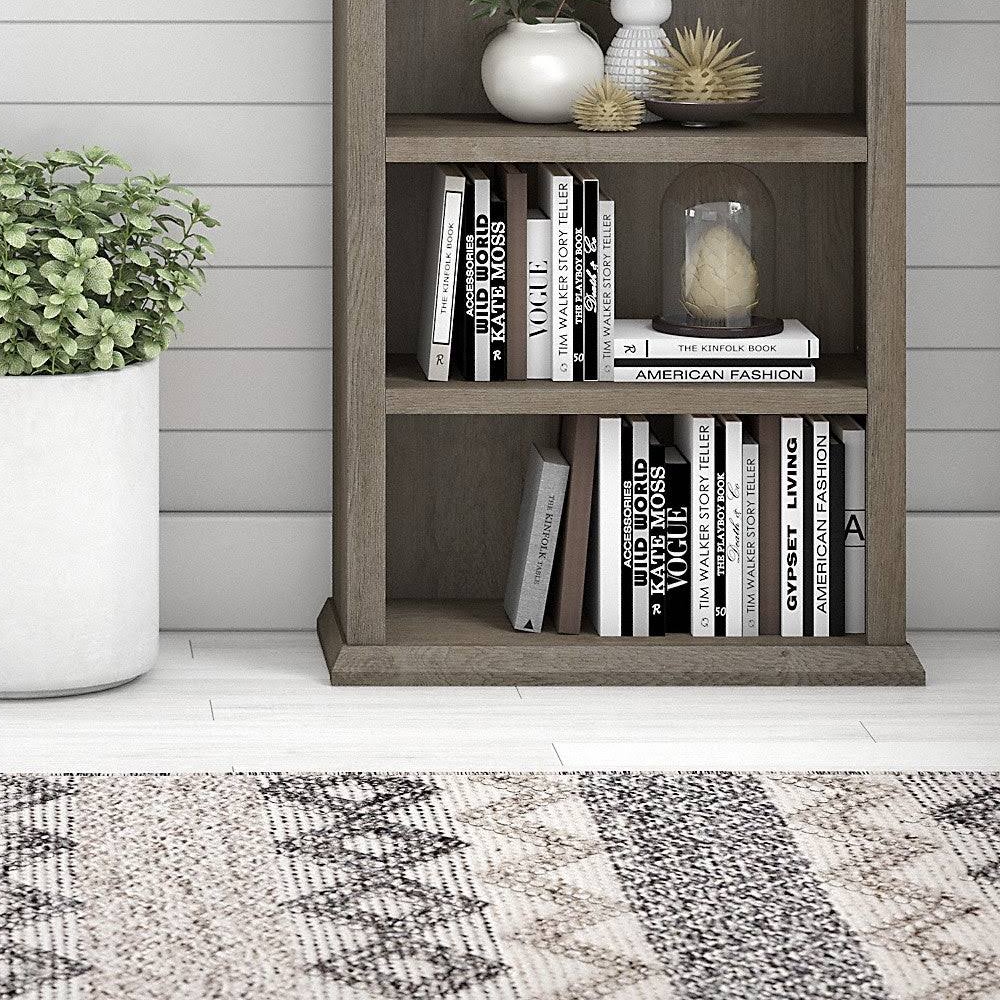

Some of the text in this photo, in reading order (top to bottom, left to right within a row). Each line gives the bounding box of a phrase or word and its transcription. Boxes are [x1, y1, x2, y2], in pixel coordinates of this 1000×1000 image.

[443, 253, 452, 295] KINFOLK
[447, 223, 455, 249] BOOK
[466, 234, 474, 317] ACCESSORIES
[476, 214, 489, 334] WILD WORLD
[491, 221, 505, 343] KATE MOSS
[558, 183, 568, 356] TIM WALKER STORY TELLER
[575, 227, 583, 325] THE PLAYBOY BOOK
[529, 261, 548, 337] VOGUE
[585, 267, 598, 313] Death
[603, 214, 612, 360] TIM WALKER STORY TELLER
[636, 370, 803, 380] AMERICAN FASHION
[534, 495, 556, 585] THE KINFOLK TABLE
[624, 481, 632, 568] ACCESSORIES
[634, 458, 648, 587] WILD WORLD
[650, 466, 665, 595] KATE MOSS
[667, 507, 688, 591] VOGUE
[699, 425, 709, 609] TIM WALKER STORY TELLER
[717, 472, 725, 576] THE PLAYBOY BOOK
[727, 518, 740, 563] Death
[747, 458, 756, 613] TIM WALKER STORY TELLER
[787, 437, 797, 611] GYPSET LIVING
[817, 435, 827, 614] AMERICAN FASHION
[845, 514, 866, 541] A
[715, 607, 726, 616] 50
